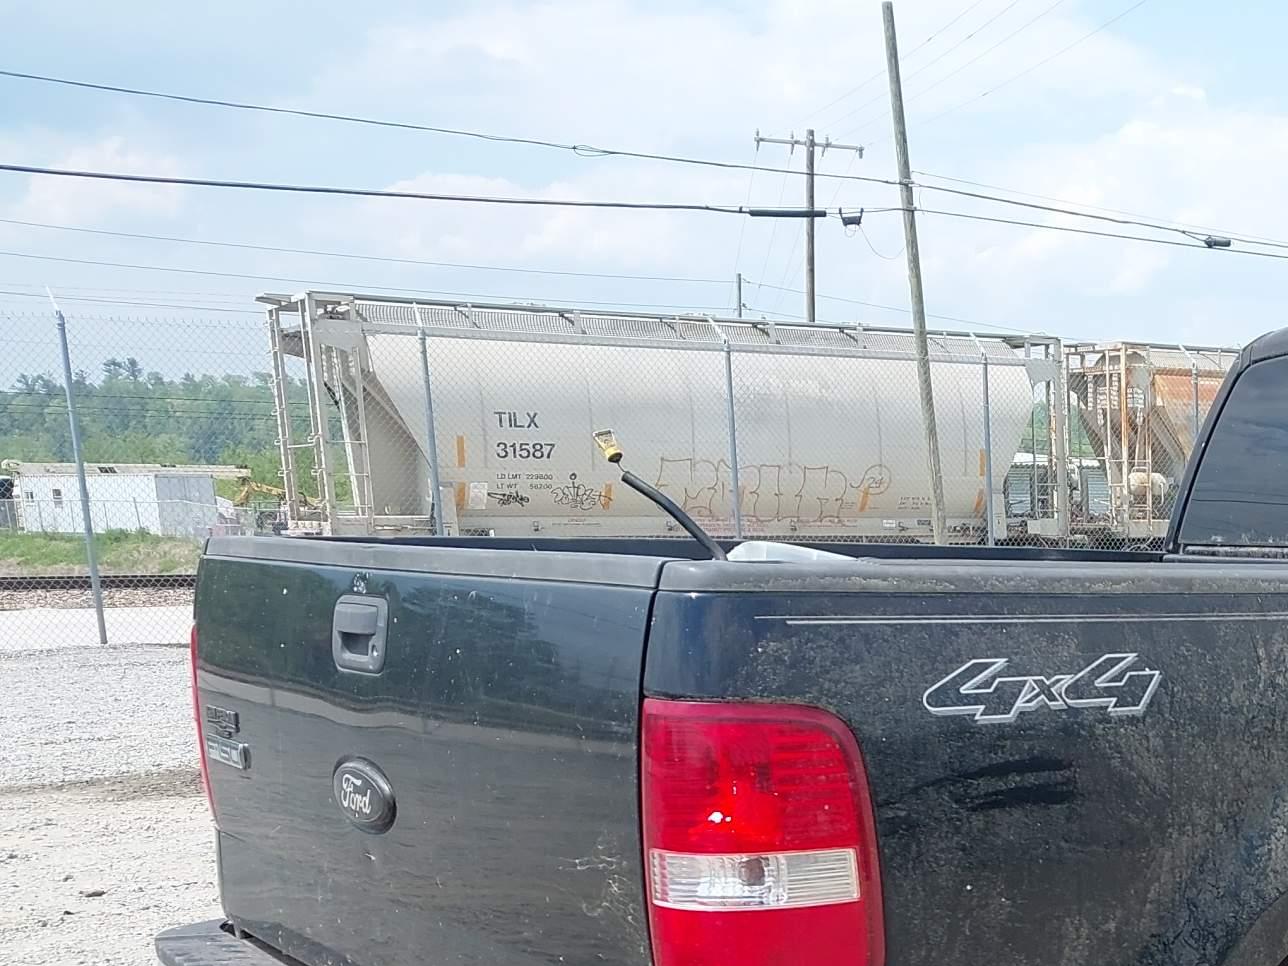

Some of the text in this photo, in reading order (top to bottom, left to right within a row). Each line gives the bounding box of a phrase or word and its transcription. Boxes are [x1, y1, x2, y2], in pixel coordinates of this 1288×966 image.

[494, 411, 540, 429] TILX
[496, 442, 556, 460] 31587
[341, 773, 372, 815] Ford
